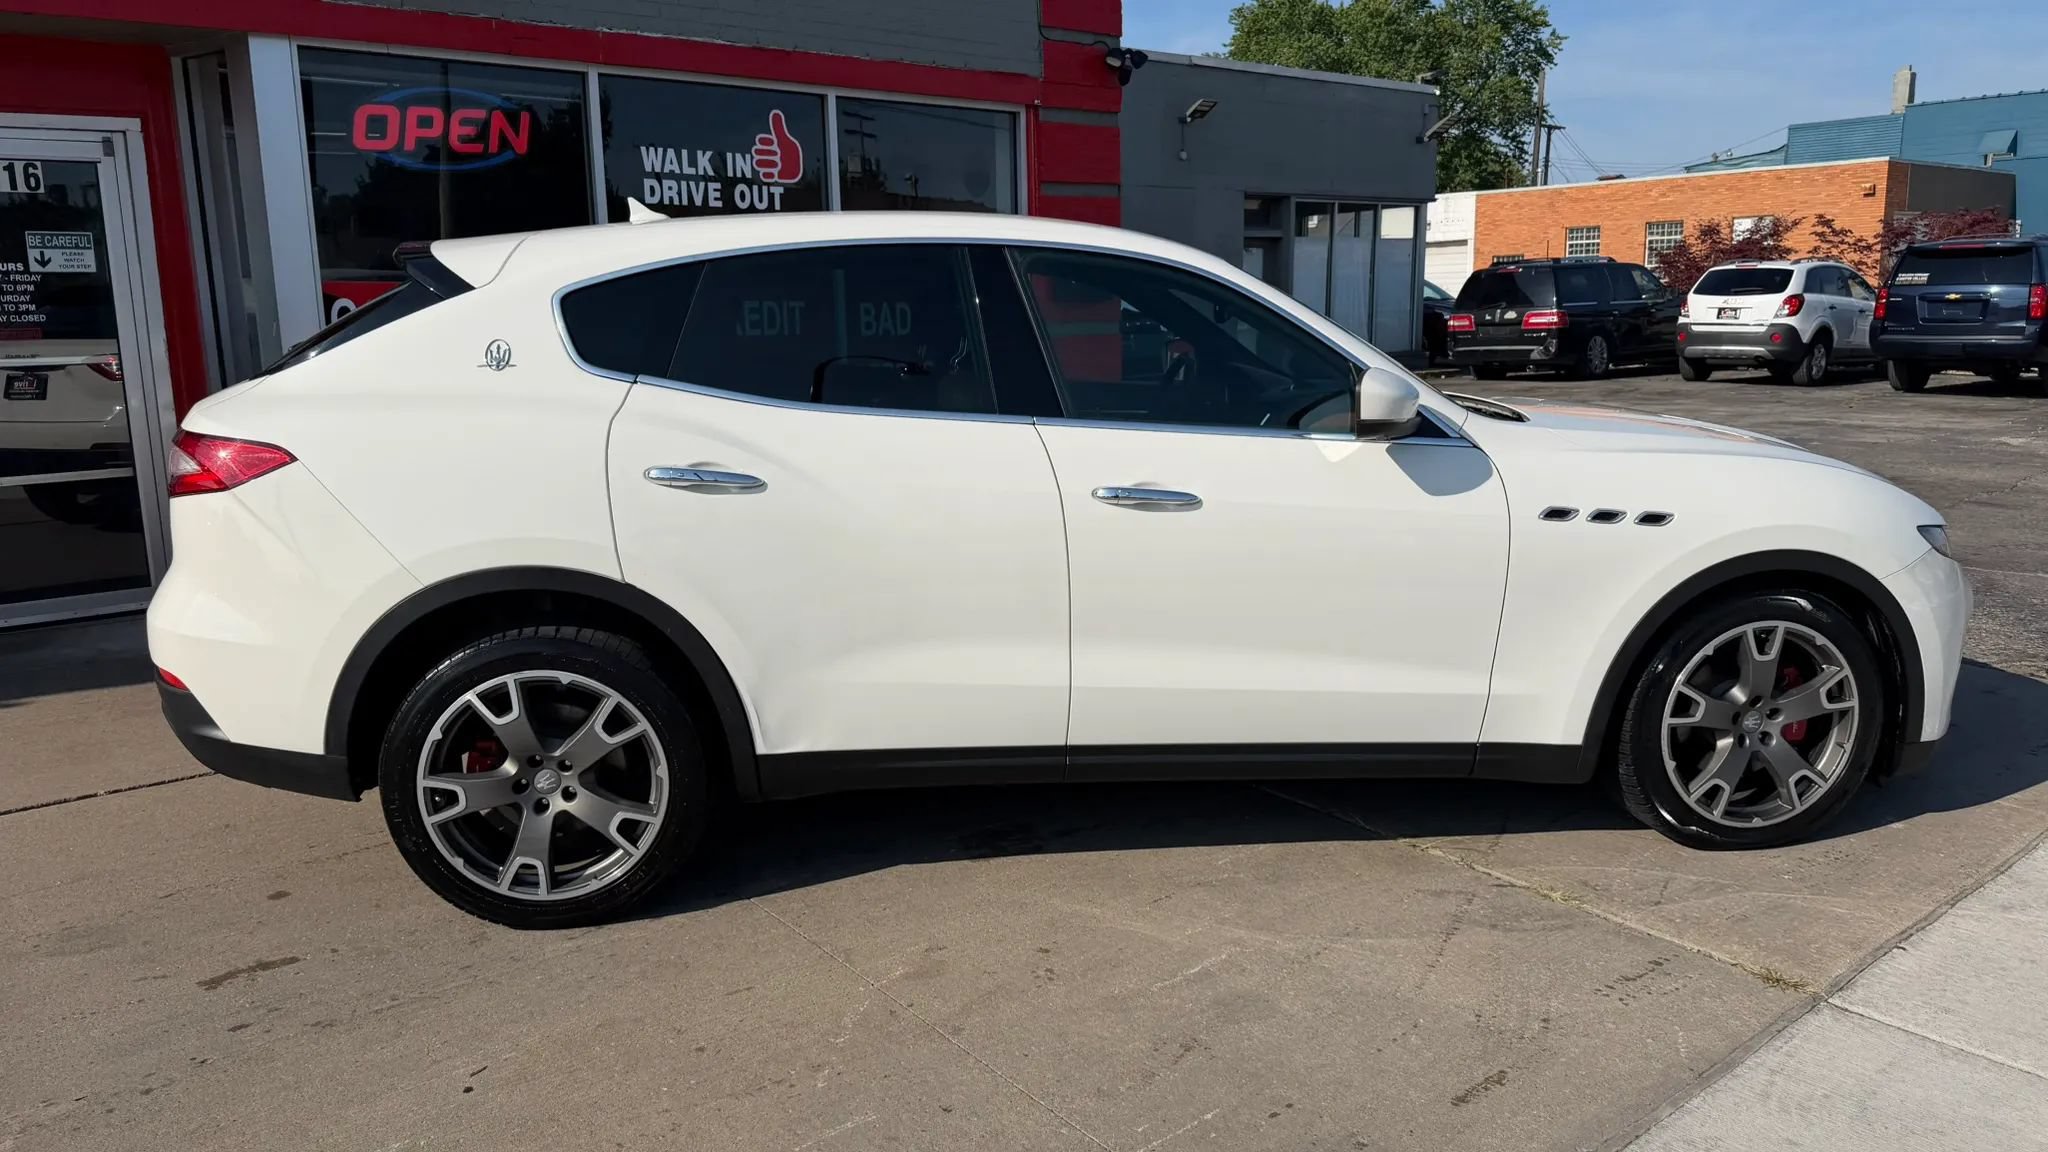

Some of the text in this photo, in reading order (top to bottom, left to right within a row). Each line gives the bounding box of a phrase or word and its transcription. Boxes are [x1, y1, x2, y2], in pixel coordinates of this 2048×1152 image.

[352, 104, 530, 155] OPEN
[640, 146, 752, 178] WALK IN
[2, 161, 42, 192] 16
[643, 178, 784, 210] DRIVE OUT
[28, 235, 92, 248] BE CAREFUL
[0, 262, 24, 271] URS
[10, 274, 42, 282] FRIDAY
[0, 294, 31, 302] URDAY
[10, 314, 47, 322] CLOSED
[859, 301, 912, 336] BAD
